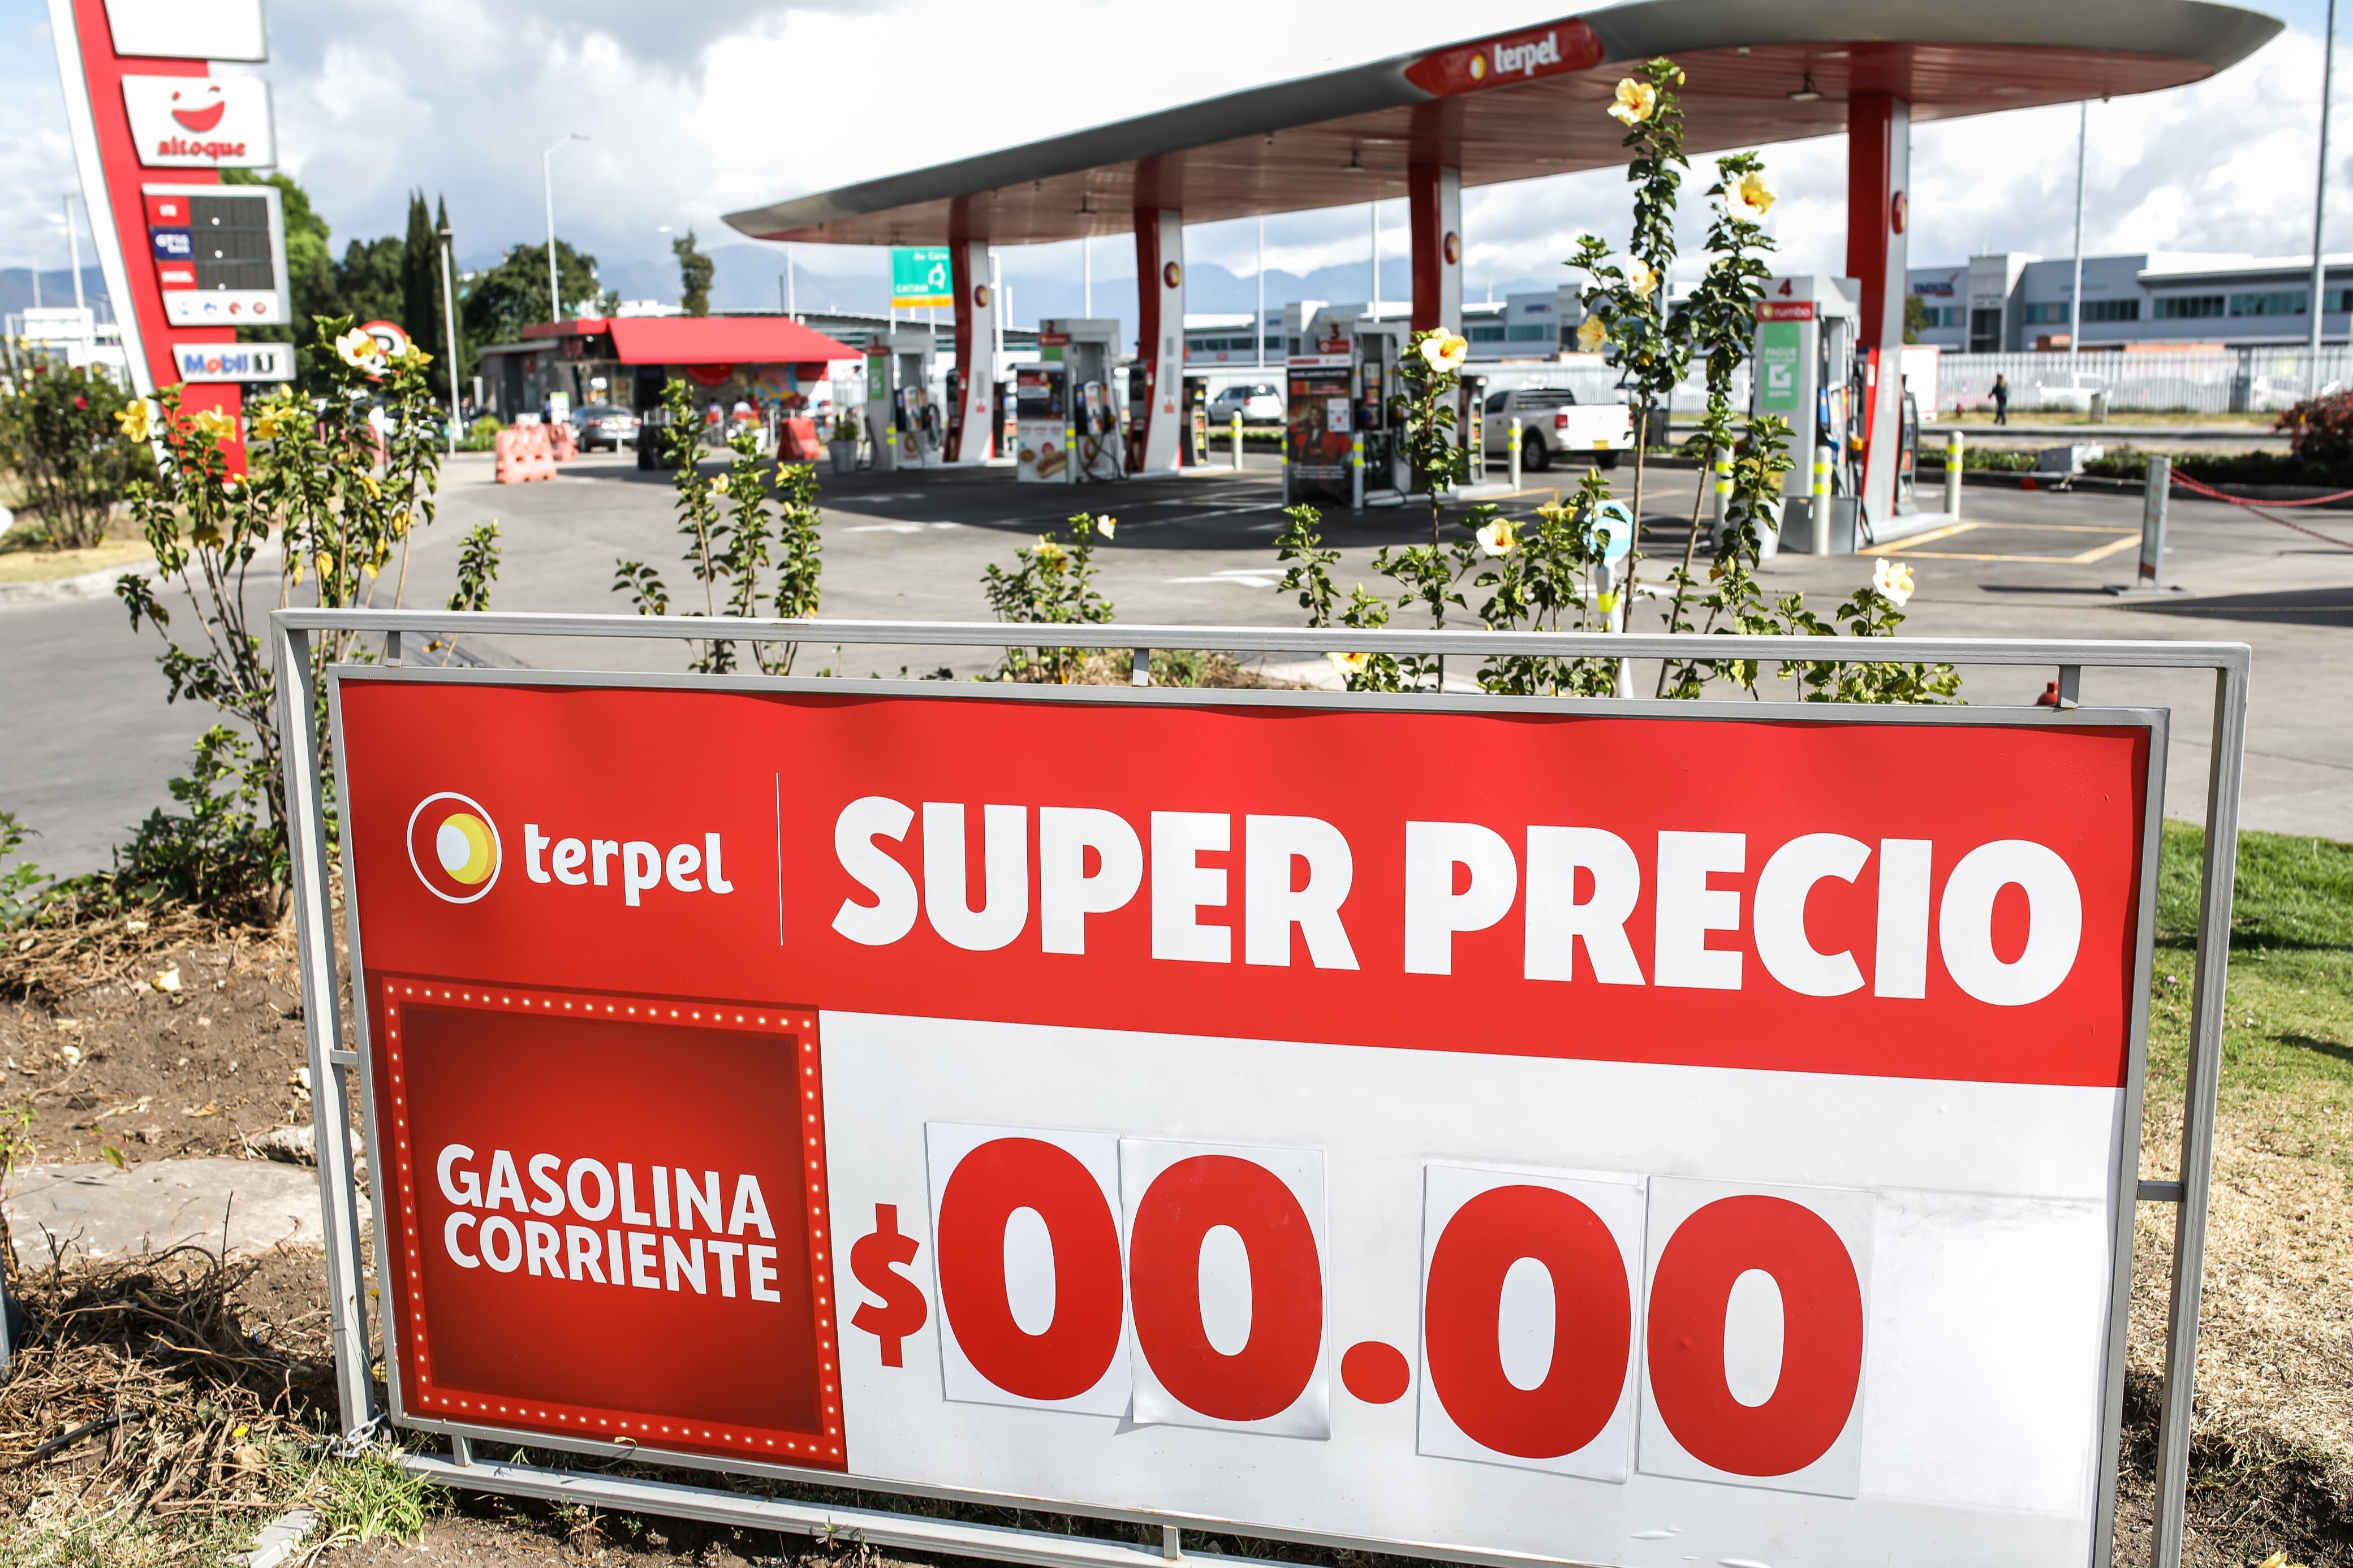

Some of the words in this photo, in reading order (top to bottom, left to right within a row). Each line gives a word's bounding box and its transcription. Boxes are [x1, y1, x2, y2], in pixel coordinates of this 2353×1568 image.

[1494, 31, 1561, 76] terpel
[1777, 278, 1793, 297] 4
[1330, 322, 1340, 340] 3
[184, 353, 248, 374] Mobil
[524, 823, 734, 907] terpel
[831, 796, 1361, 971] SUPER
[1404, 820, 2083, 1006] PRECIO
[437, 1144, 776, 1239] GASOLINA
[444, 1211, 781, 1303] CORRIENTE
